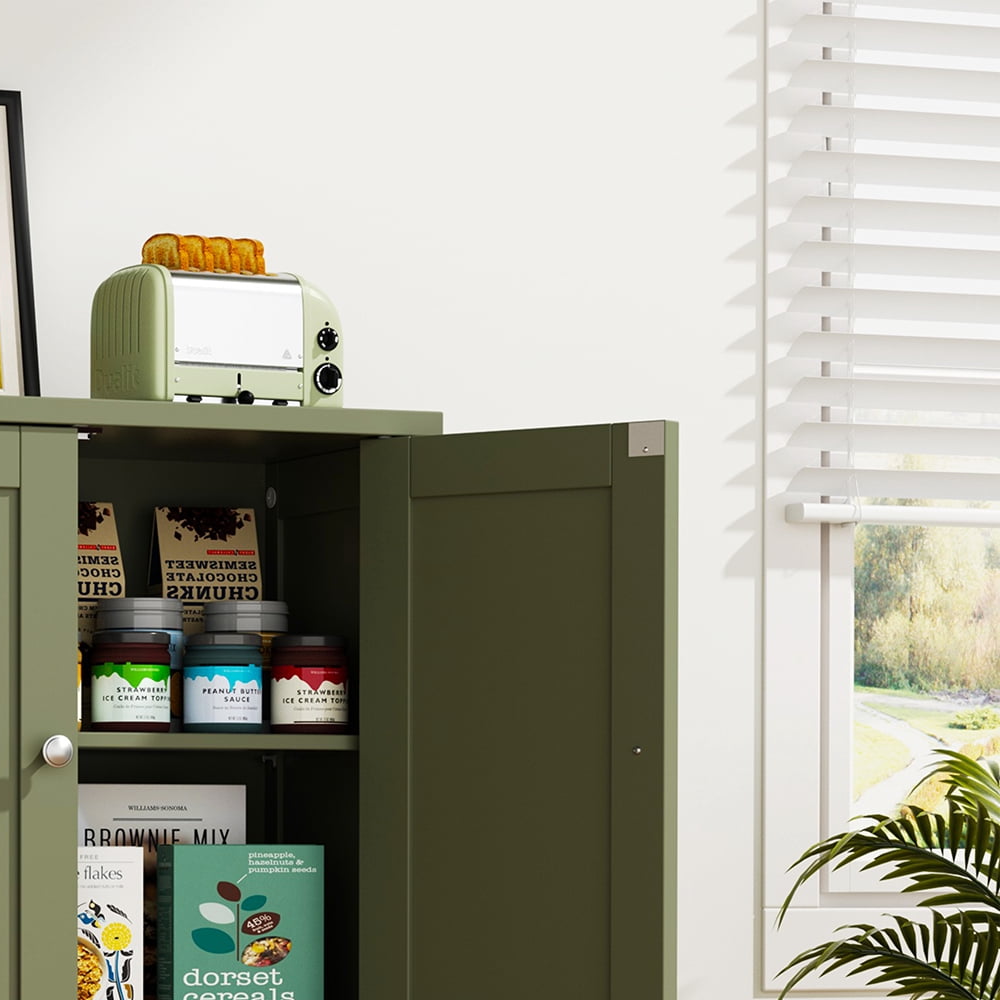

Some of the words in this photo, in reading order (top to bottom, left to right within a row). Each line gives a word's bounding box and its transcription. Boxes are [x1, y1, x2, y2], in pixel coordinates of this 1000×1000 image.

[84, 865, 123, 880] flakes
[248, 866, 290, 874] pumpkin
[182, 967, 283, 987] dorset
